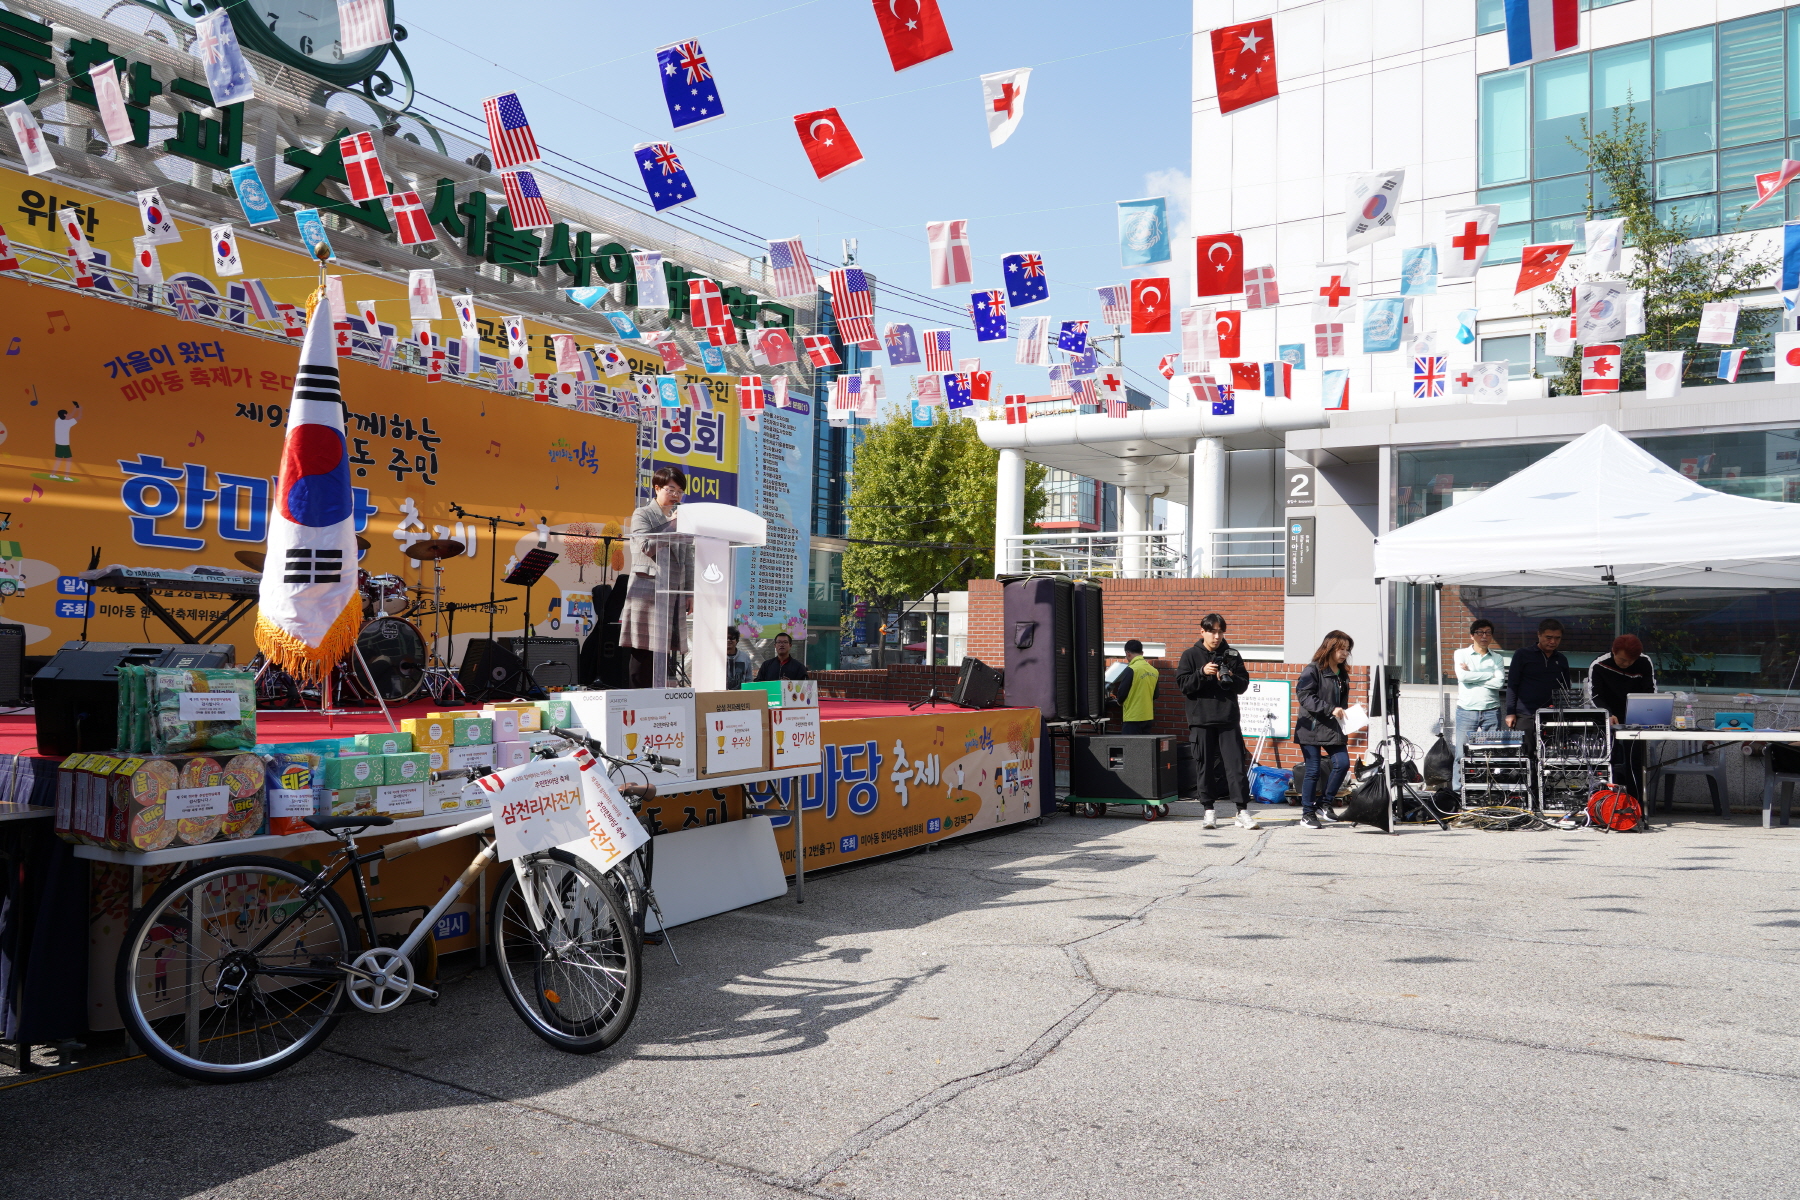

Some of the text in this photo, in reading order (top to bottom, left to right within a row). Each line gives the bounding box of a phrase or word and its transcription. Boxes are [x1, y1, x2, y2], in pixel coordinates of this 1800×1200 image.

[266, 11, 280, 33] 7
[300, 35, 313, 56] 6
[104, 339, 226, 382] 가을이 왔다
[120, 368, 186, 403] 미아동
[189, 366, 253, 392] 축제가
[388, 446, 440, 486] 주민
[573, 440, 599, 475] 강북
[1290, 473, 1310, 497] 2
[393, 496, 478, 568] 축제
[63, 577, 89, 594] 일시
[61, 602, 88, 617] 주최
[100, 604, 137, 619] 미아동
[664, 691, 694, 701] CUCKOO
[1253, 683, 1260, 693] 림
[643, 732, 685, 751] 최우수상
[731, 736, 752, 749] 우수상
[791, 731, 816, 748] 인기상
[225, 774, 241, 793] BIG
[534, 774, 570, 789] 주민한마당 축제
[890, 738, 940, 808] 축제
[141, 804, 165, 823] BIG
[233, 798, 254, 812] BIG
[501, 786, 582, 826] 삼천리자전거
[597, 800, 627, 840] 주민한마당 축제
[585, 809, 622, 864] 자전거
[808, 842, 836, 858] 2번출구)
[842, 837, 856, 850] 주최
[860, 833, 880, 846] 미아동
[881, 823, 924, 843] 한마당축제위원회
[953, 813, 975, 828] 강북구
[437, 914, 466, 935] 일시
